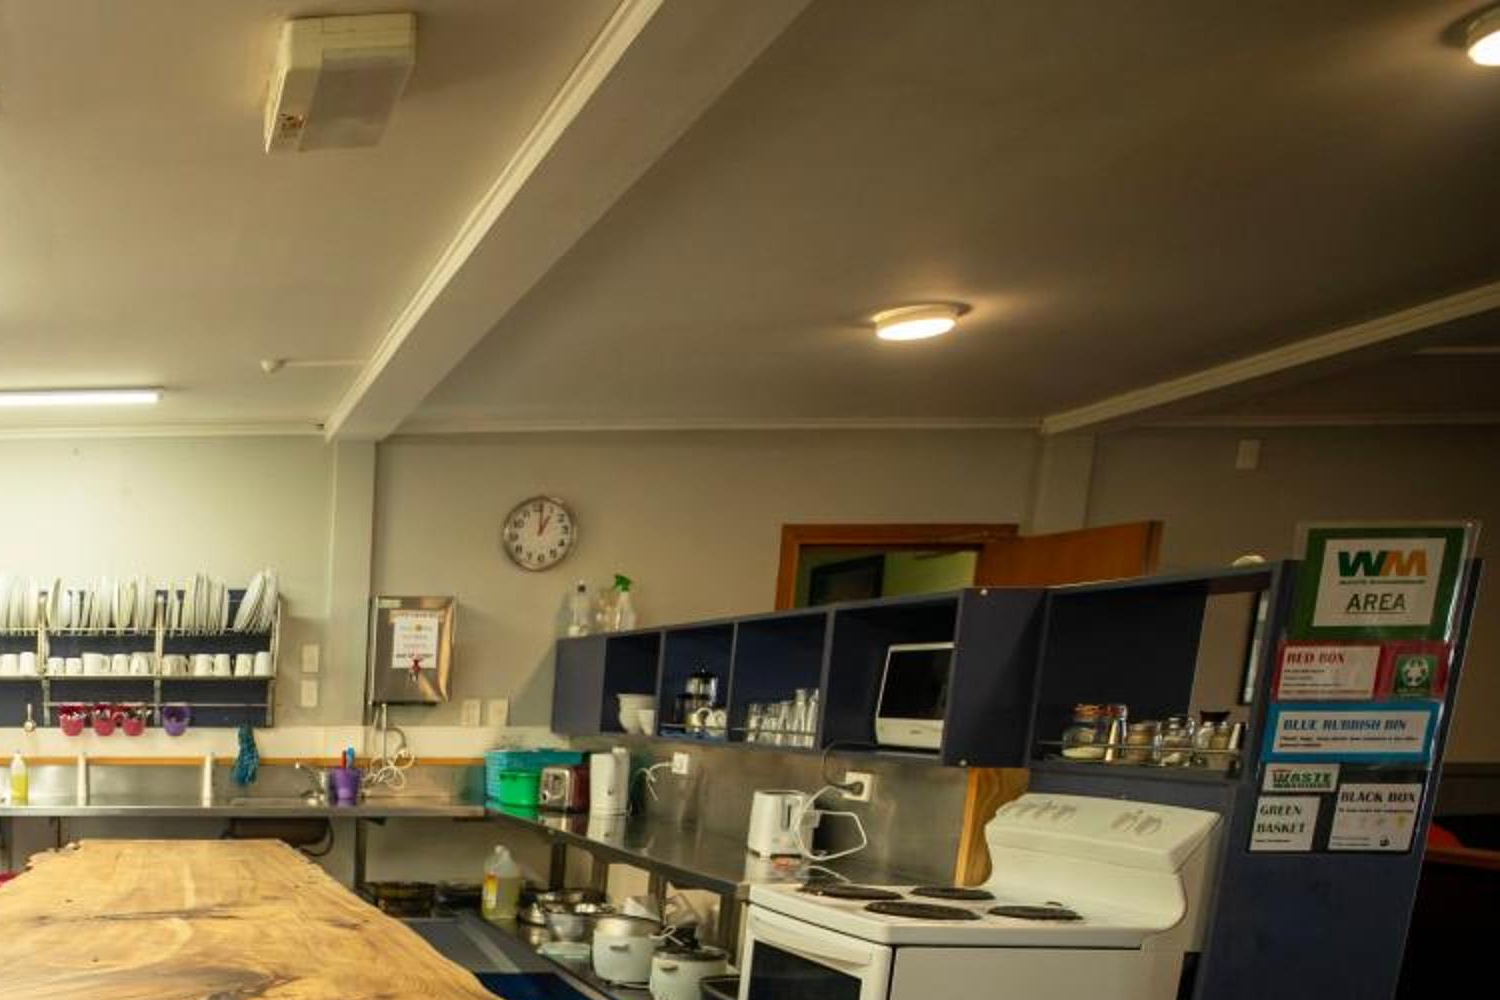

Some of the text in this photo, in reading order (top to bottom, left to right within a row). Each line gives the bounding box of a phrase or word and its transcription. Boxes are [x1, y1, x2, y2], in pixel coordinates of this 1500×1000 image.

[1338, 550, 1429, 577] WM
[1346, 593, 1406, 611] AREA
[1286, 652, 1346, 665] RED BOX
[1283, 719, 1407, 731] BLUE RUBBISH BIN
[1341, 791, 1415, 803] BLACK BOX
[1260, 804, 1302, 817] GREEN
[1256, 822, 1306, 834] BASKET
